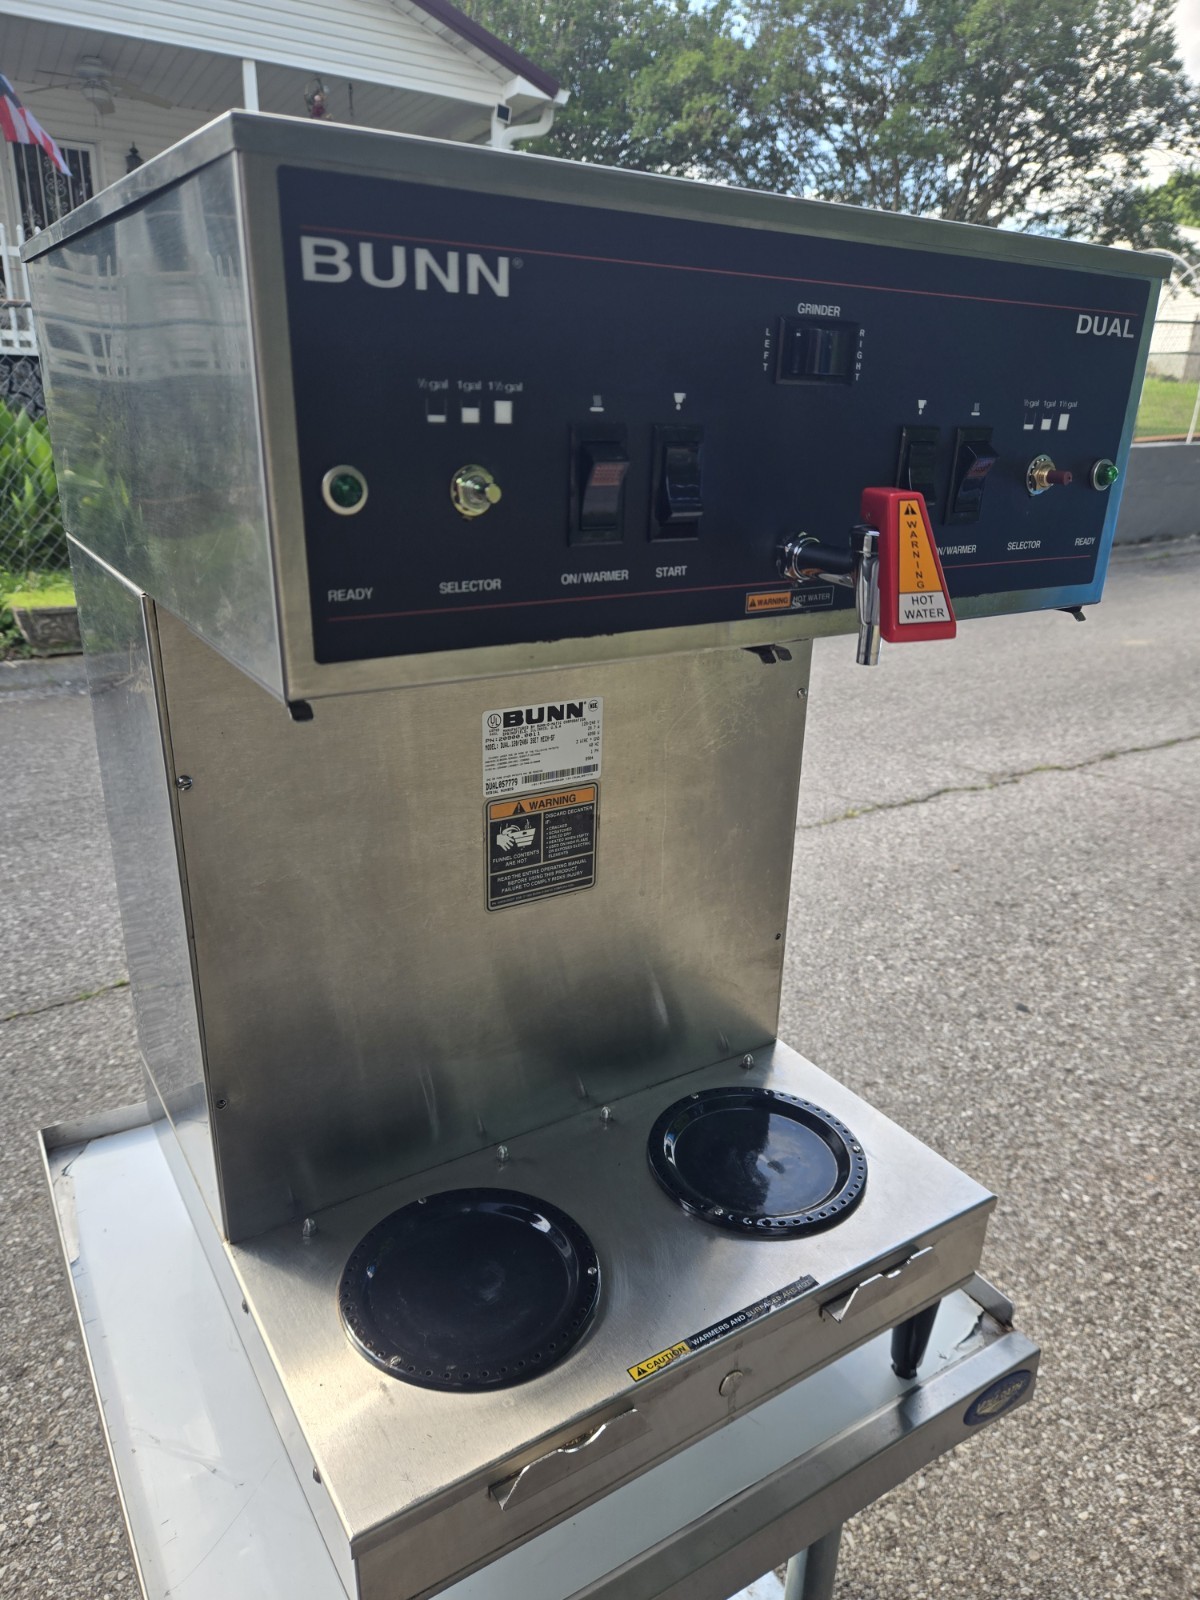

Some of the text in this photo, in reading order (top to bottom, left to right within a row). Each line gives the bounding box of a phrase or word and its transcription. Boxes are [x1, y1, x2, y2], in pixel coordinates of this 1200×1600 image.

[300, 236, 510, 297] BUNN
[797, 303, 841, 317] GRINDER
[1076, 314, 1135, 338] DUAL
[763, 328, 771, 371] LEFT
[855, 329, 865, 381] RIGHT
[1007, 540, 1041, 551] SELECTOR
[1075, 537, 1096, 547] READY
[906, 520, 925, 589] WARNING
[937, 544, 977, 556] N/WARMER
[561, 569, 629, 585] ON/WARMER
[655, 565, 688, 578] START
[439, 579, 502, 594] SELECTOR
[328, 587, 373, 602] READY
[757, 597, 789, 606] WARNING
[808, 593, 831, 602] WATER
[911, 595, 935, 606] HOT
[904, 608, 945, 620] WATER
[503, 702, 583, 728] BUNN
[529, 794, 577, 810] WARNING
[646, 1345, 687, 1370] CAUTION
[691, 1323, 730, 1346] WARMERS
[730, 1314, 746, 1327] AND
[782, 1287, 797, 1299] ARE
